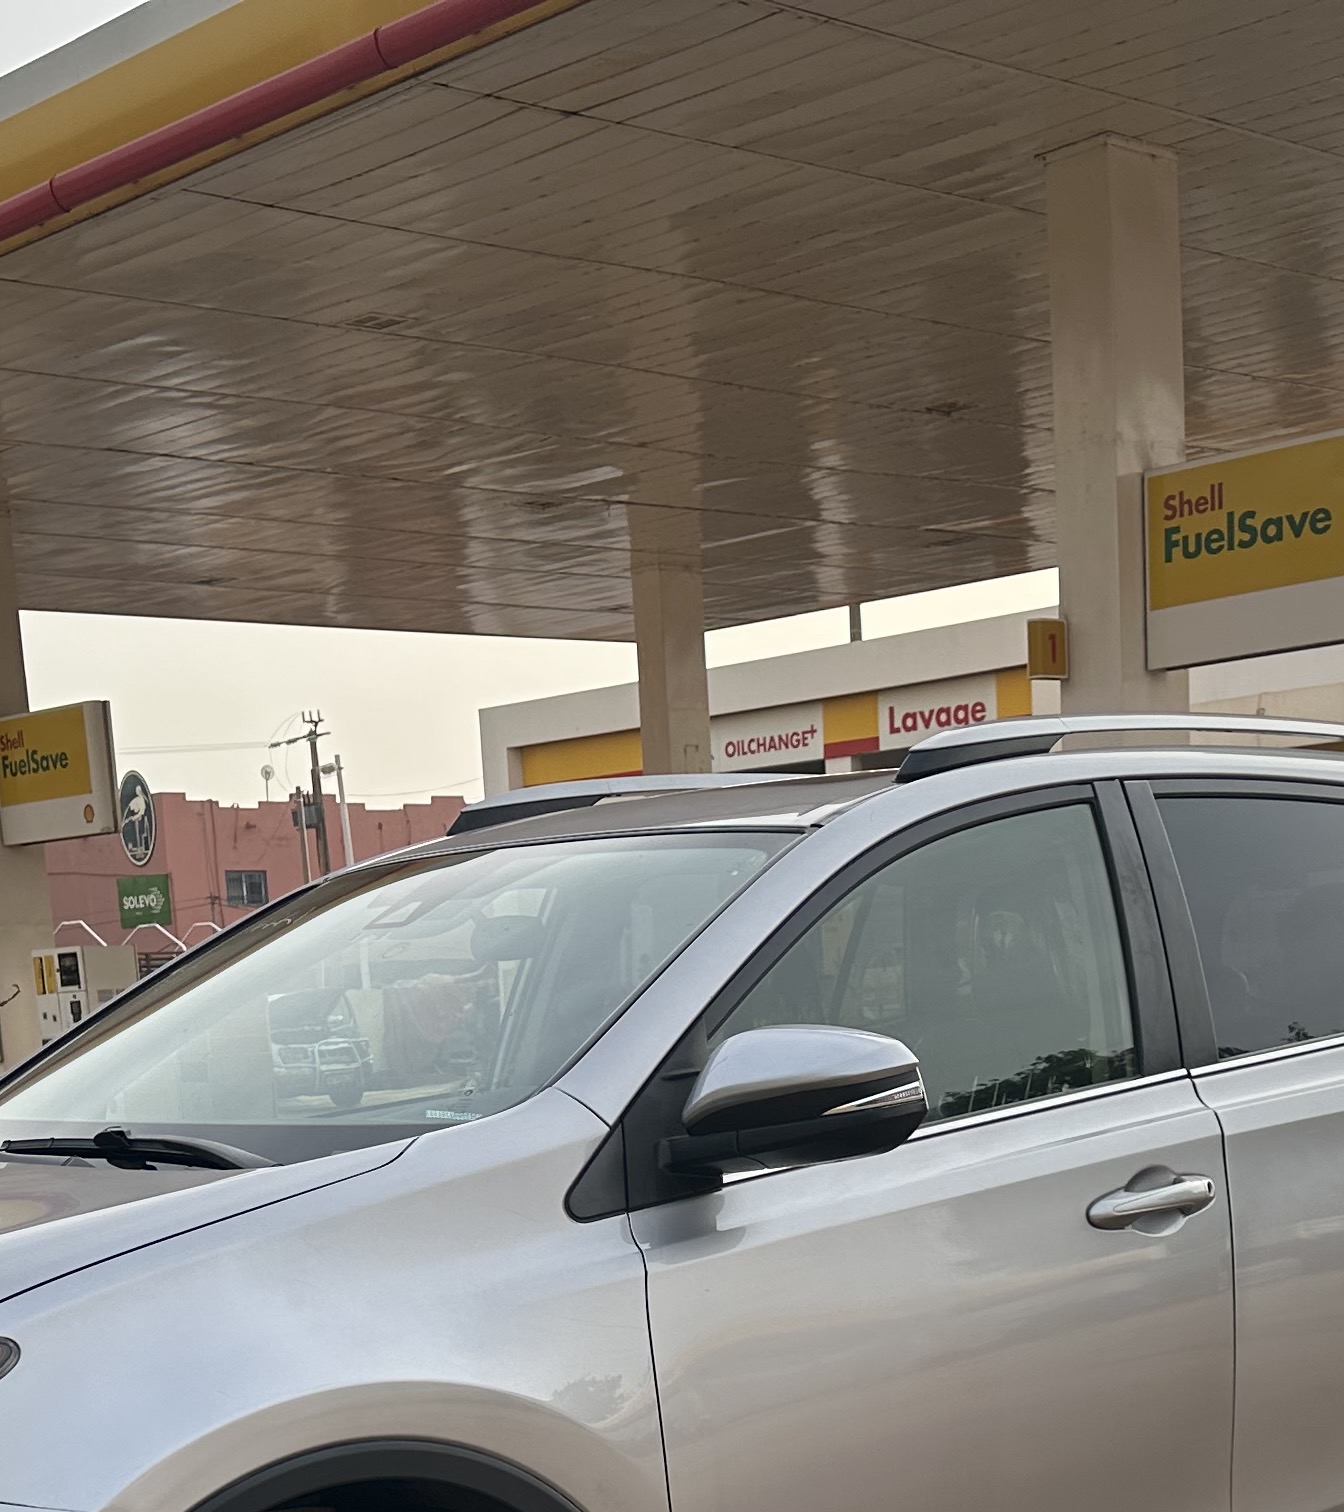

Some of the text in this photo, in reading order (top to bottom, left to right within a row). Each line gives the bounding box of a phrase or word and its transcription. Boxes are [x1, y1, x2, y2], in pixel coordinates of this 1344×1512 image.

[1163, 482, 1224, 521] Shell
[1163, 507, 1333, 564] FuelSave
[1047, 633, 1057, 665] 1
[888, 701, 987, 735] Lavage
[0, 729, 25, 752] Shell
[1, 748, 69, 779] FuelSave
[122, 894, 157, 910] SOLEVO
